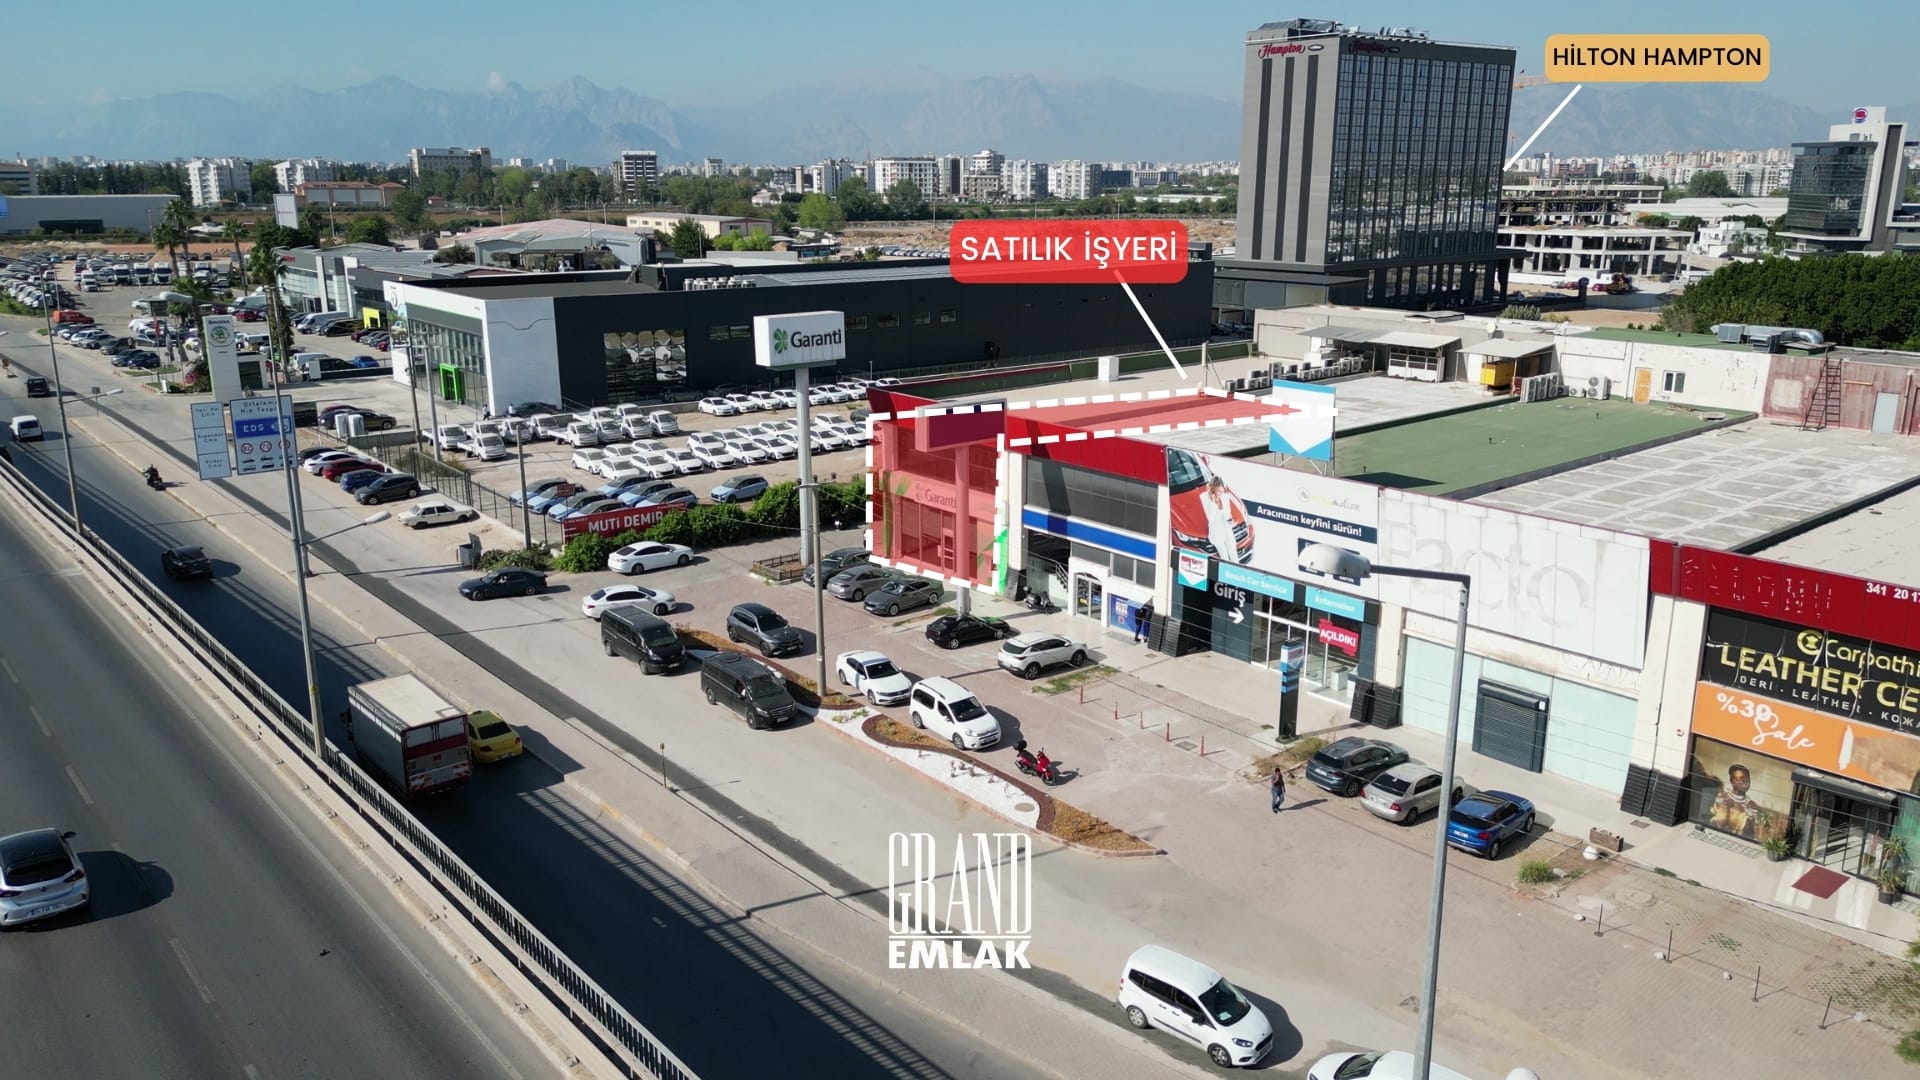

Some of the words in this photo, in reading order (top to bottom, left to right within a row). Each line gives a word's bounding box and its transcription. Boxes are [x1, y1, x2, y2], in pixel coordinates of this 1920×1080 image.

[1258, 43, 1306, 59] Hampton
[791, 328, 842, 348] Garanti
[243, 424, 265, 433] EDS
[1257, 505, 1299, 523] Aracınızın
[1300, 514, 1331, 530] keyfini
[1332, 523, 1362, 537] sürün!
[1213, 582, 1247, 608] Giriş
[1866, 582, 1887, 596] 341
[1893, 588, 1909, 600] 20
[1720, 642, 1863, 699] LEATHER
[1752, 708, 1815, 750] Sale
